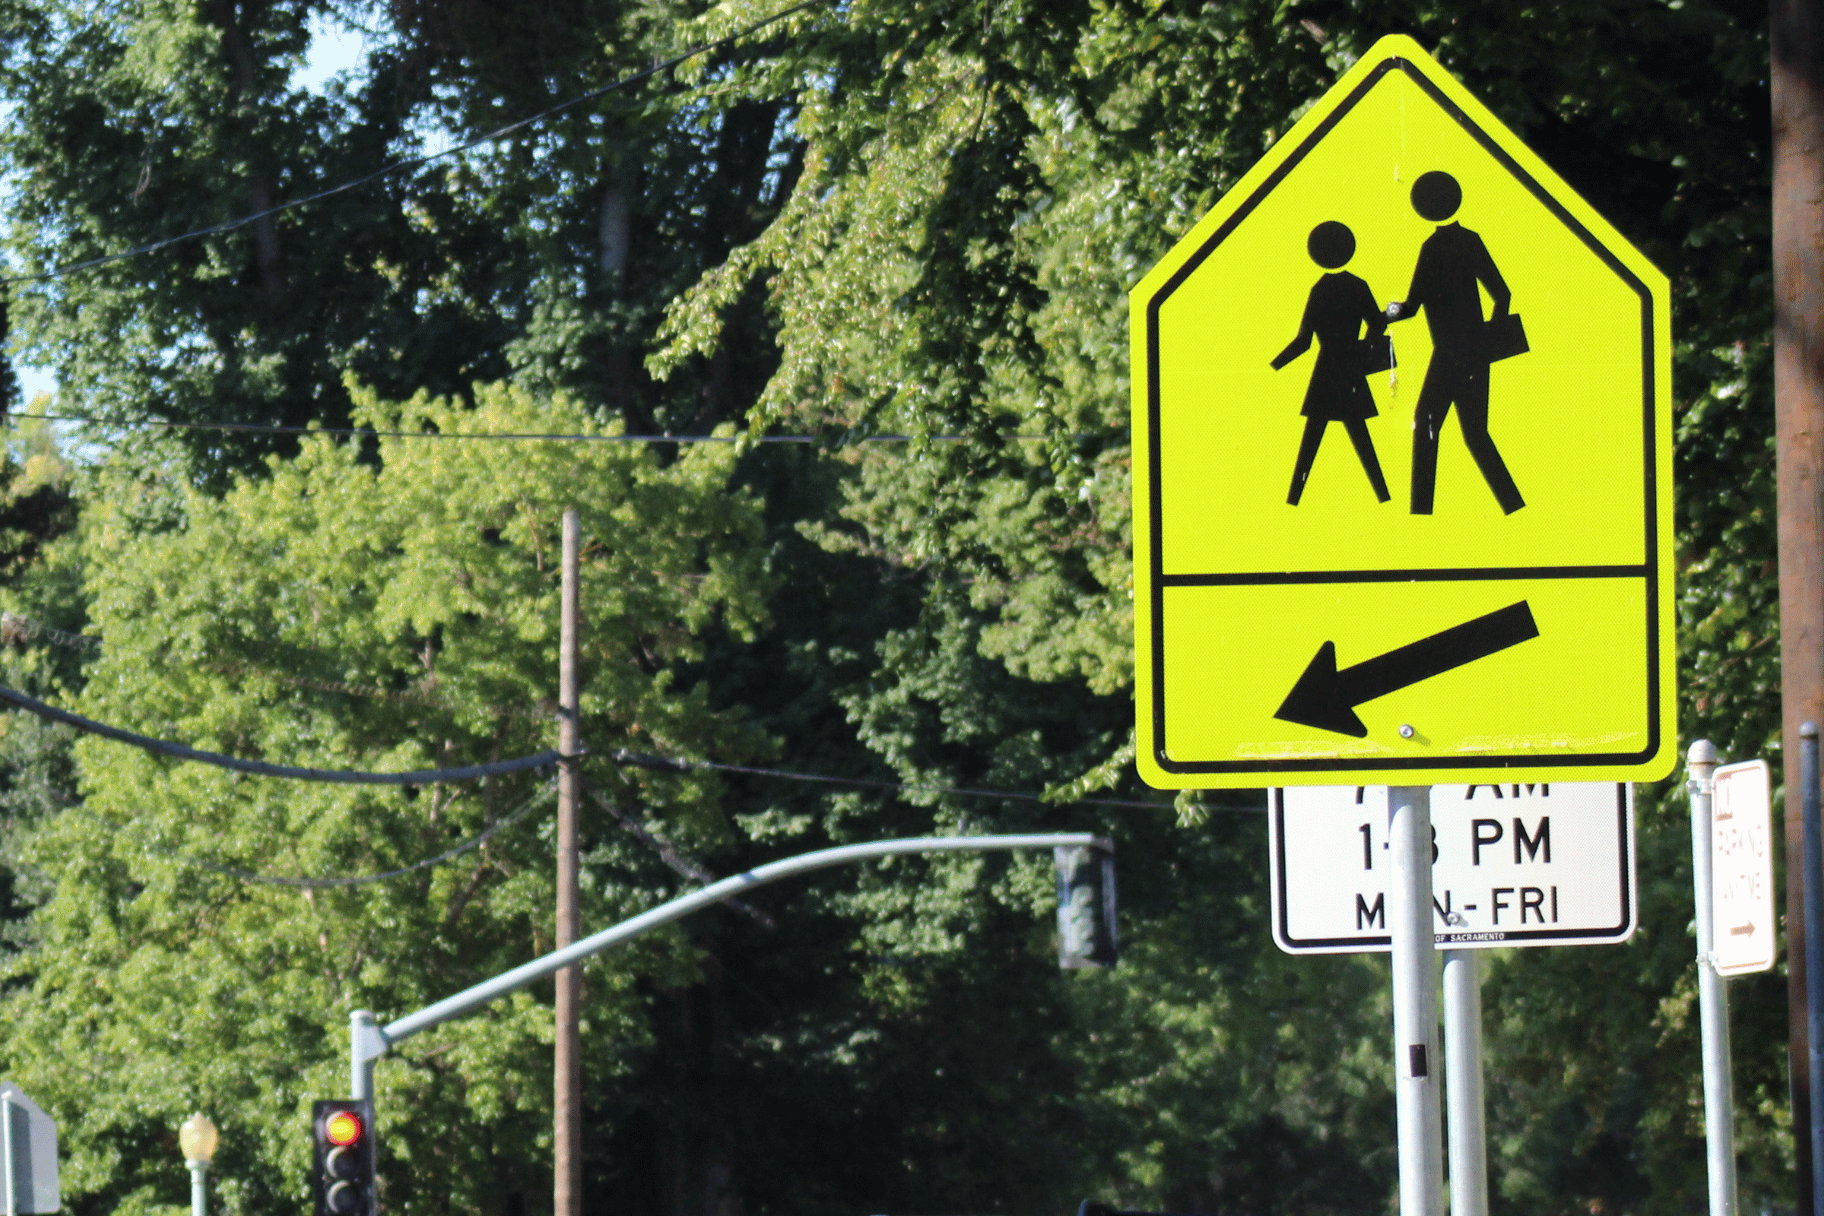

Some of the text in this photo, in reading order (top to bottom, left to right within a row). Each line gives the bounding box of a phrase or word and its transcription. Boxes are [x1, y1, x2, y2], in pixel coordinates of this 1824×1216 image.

[1471, 816, 1551, 866] PM
[1355, 886, 1558, 930] MN-FRI
[1435, 932, 1505, 943] OF SACRAMENTO
